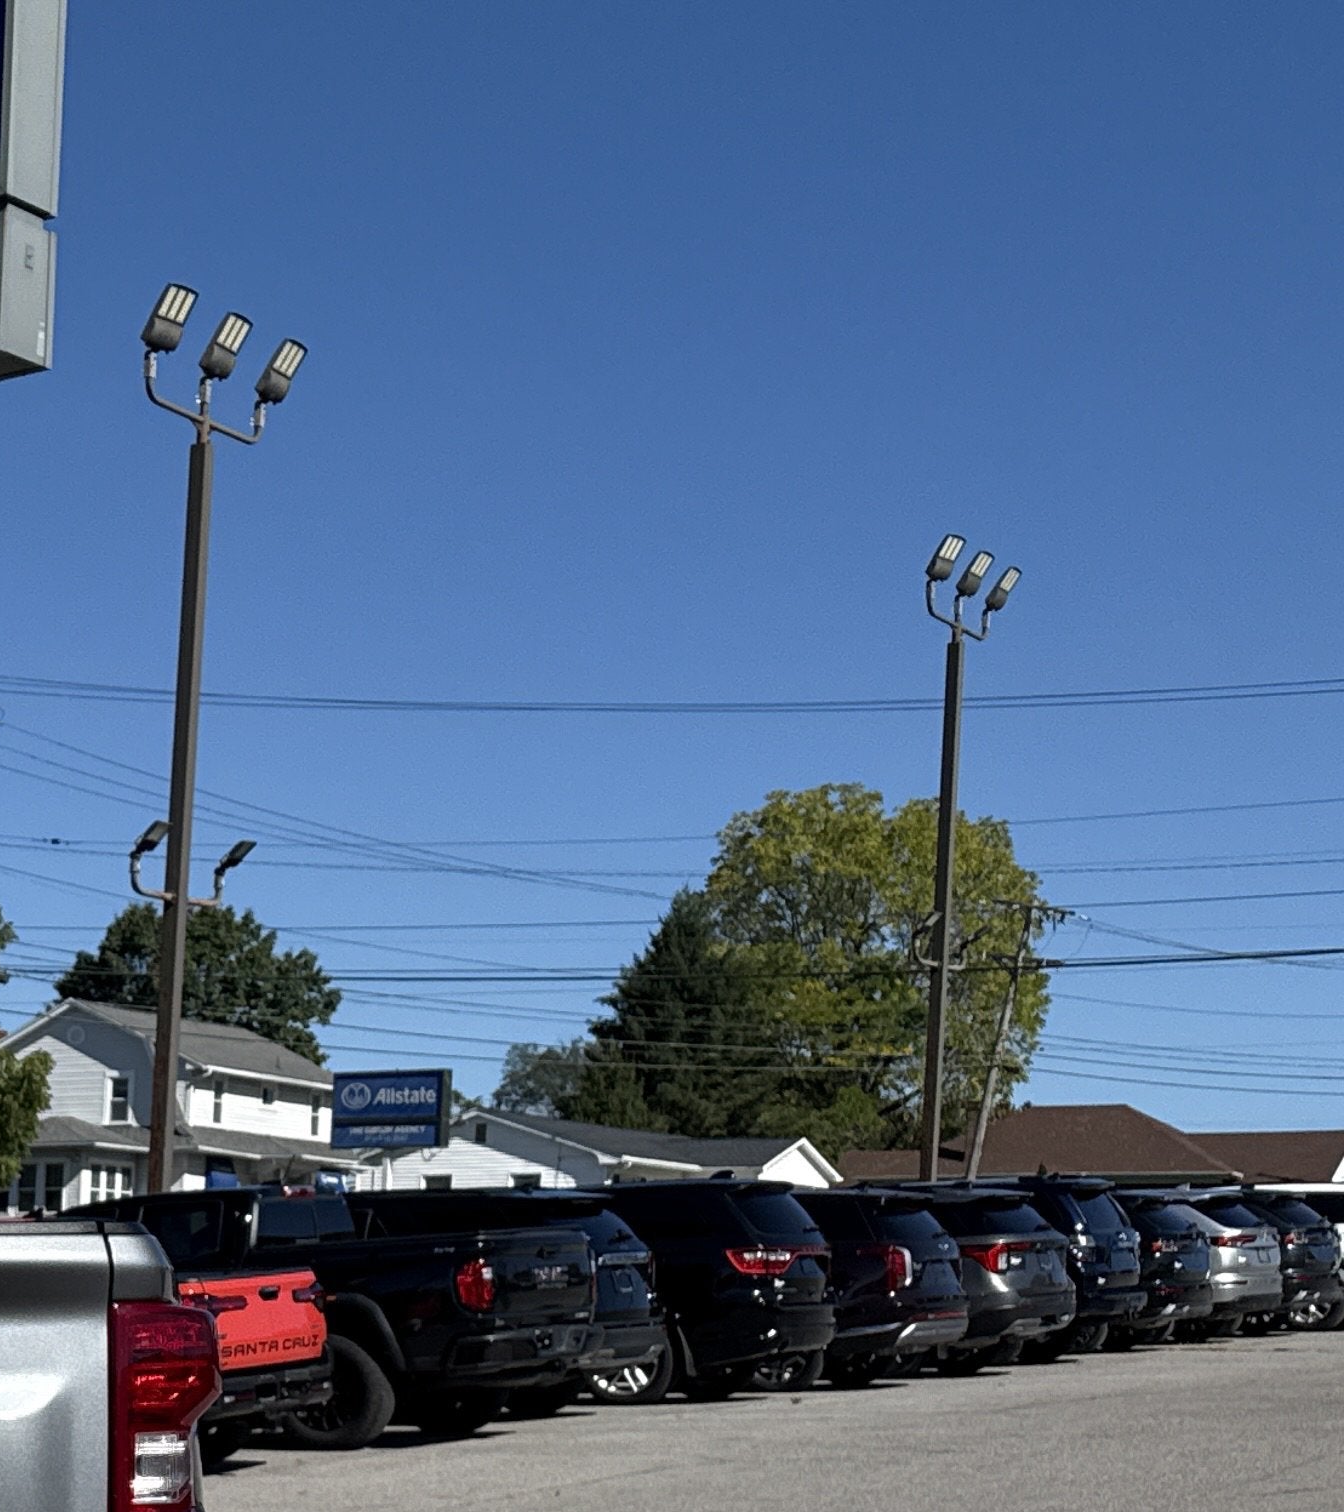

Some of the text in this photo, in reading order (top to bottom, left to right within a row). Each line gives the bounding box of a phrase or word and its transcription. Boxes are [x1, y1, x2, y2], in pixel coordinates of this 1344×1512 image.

[372, 1086, 437, 1105] Allstate
[221, 1334, 320, 1358] SANTA CRUZ
